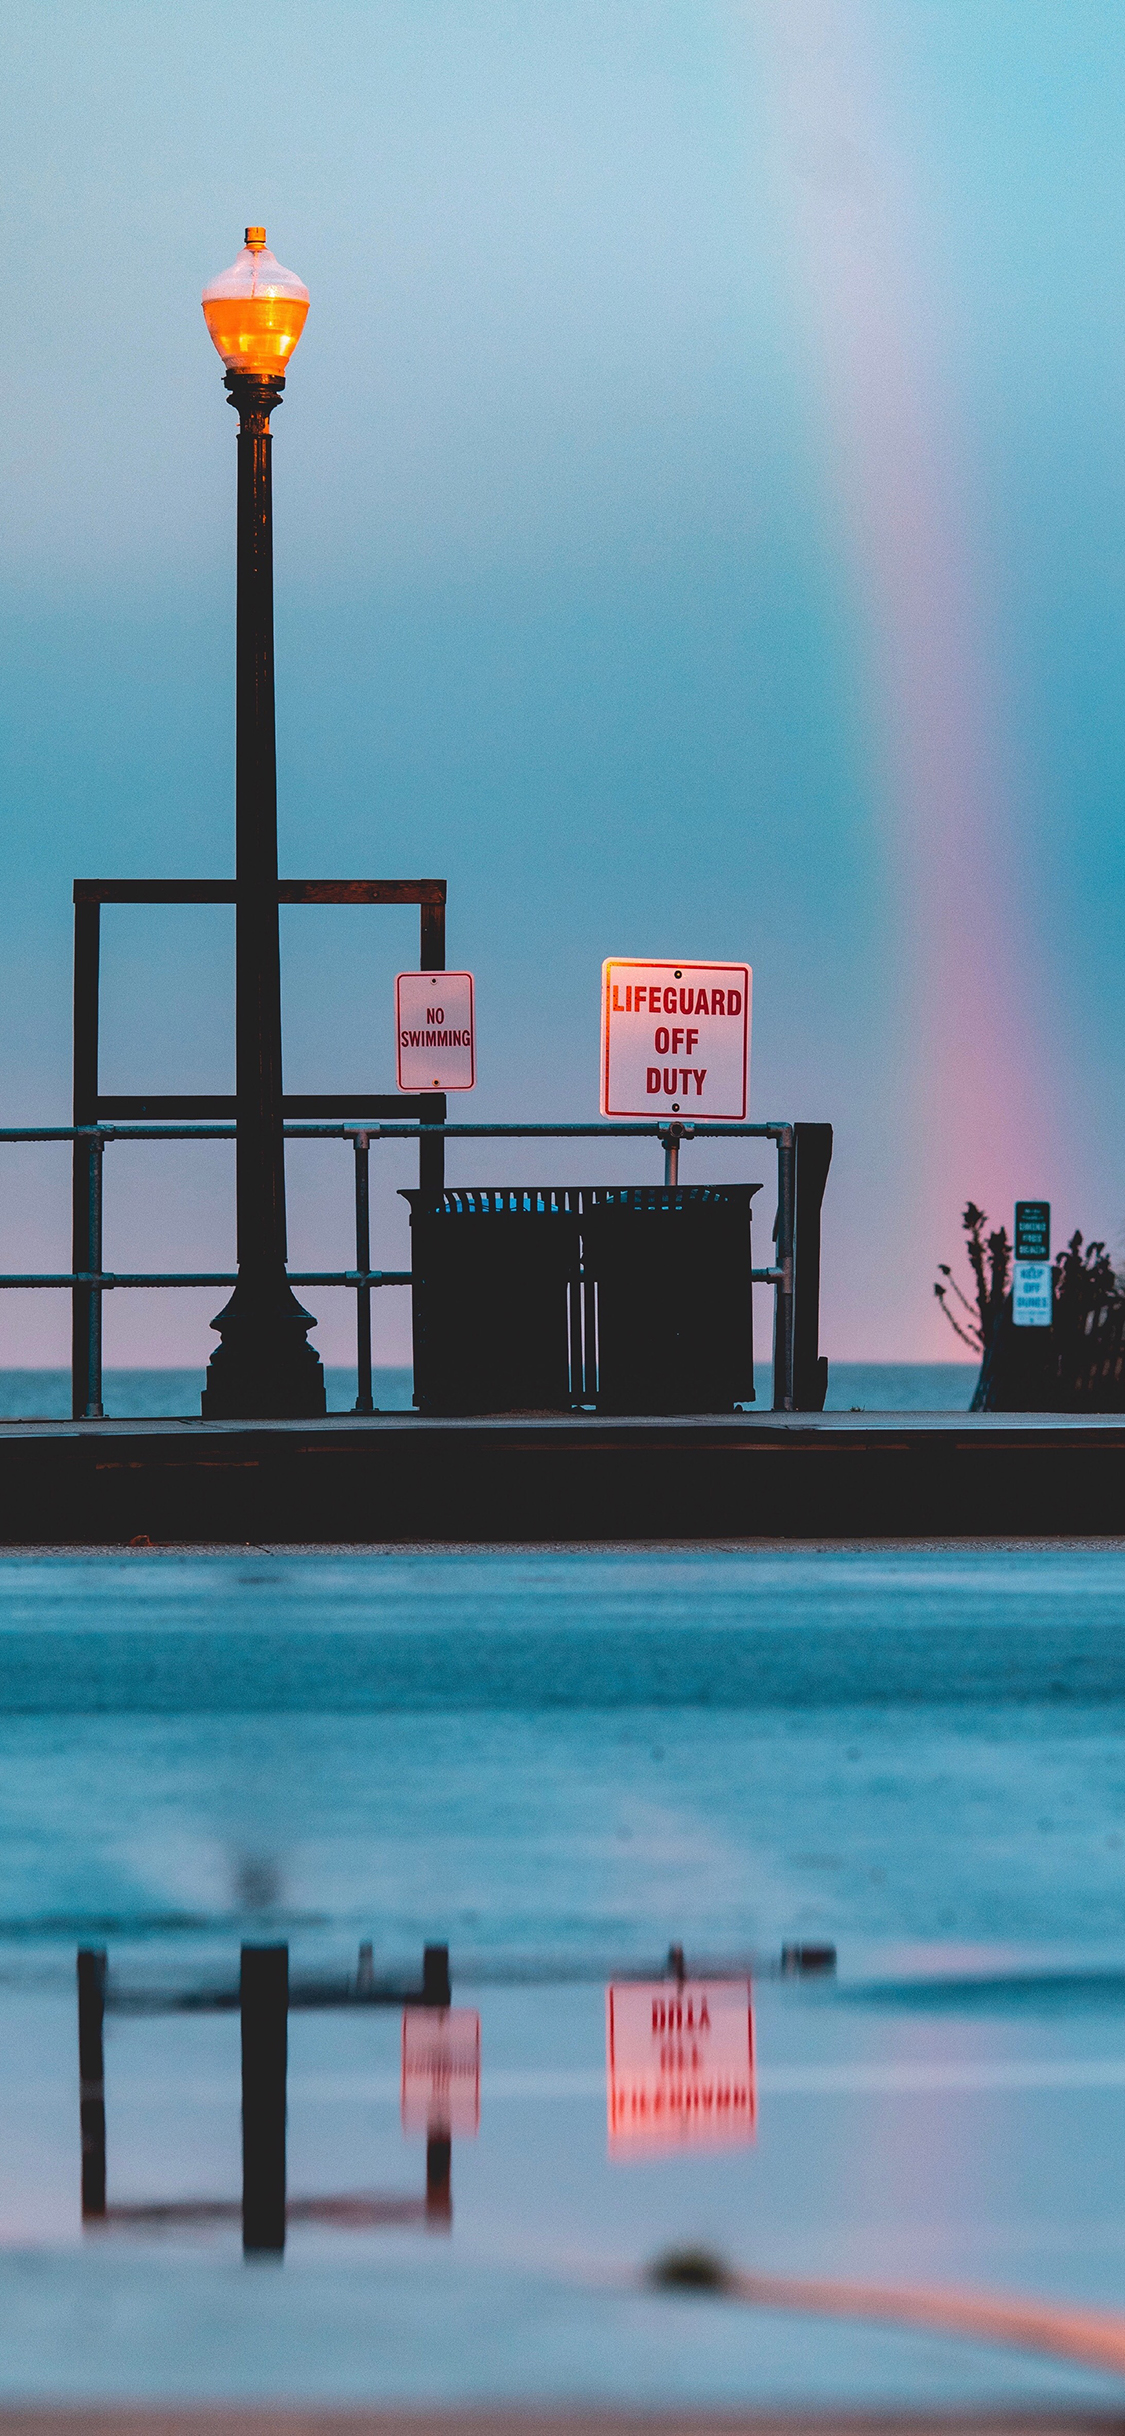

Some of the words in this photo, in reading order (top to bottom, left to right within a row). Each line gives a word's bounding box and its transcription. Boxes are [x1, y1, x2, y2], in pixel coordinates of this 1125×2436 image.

[612, 985, 742, 1016] LIFEGUARD
[426, 1007, 445, 1025] NO
[401, 1030, 471, 1047] SWIMMING
[654, 1027, 699, 1055] OFF
[646, 1067, 707, 1095] DUTY
[1020, 1269, 1044, 1279] KEEP
[1023, 1282, 1040, 1294] OFF
